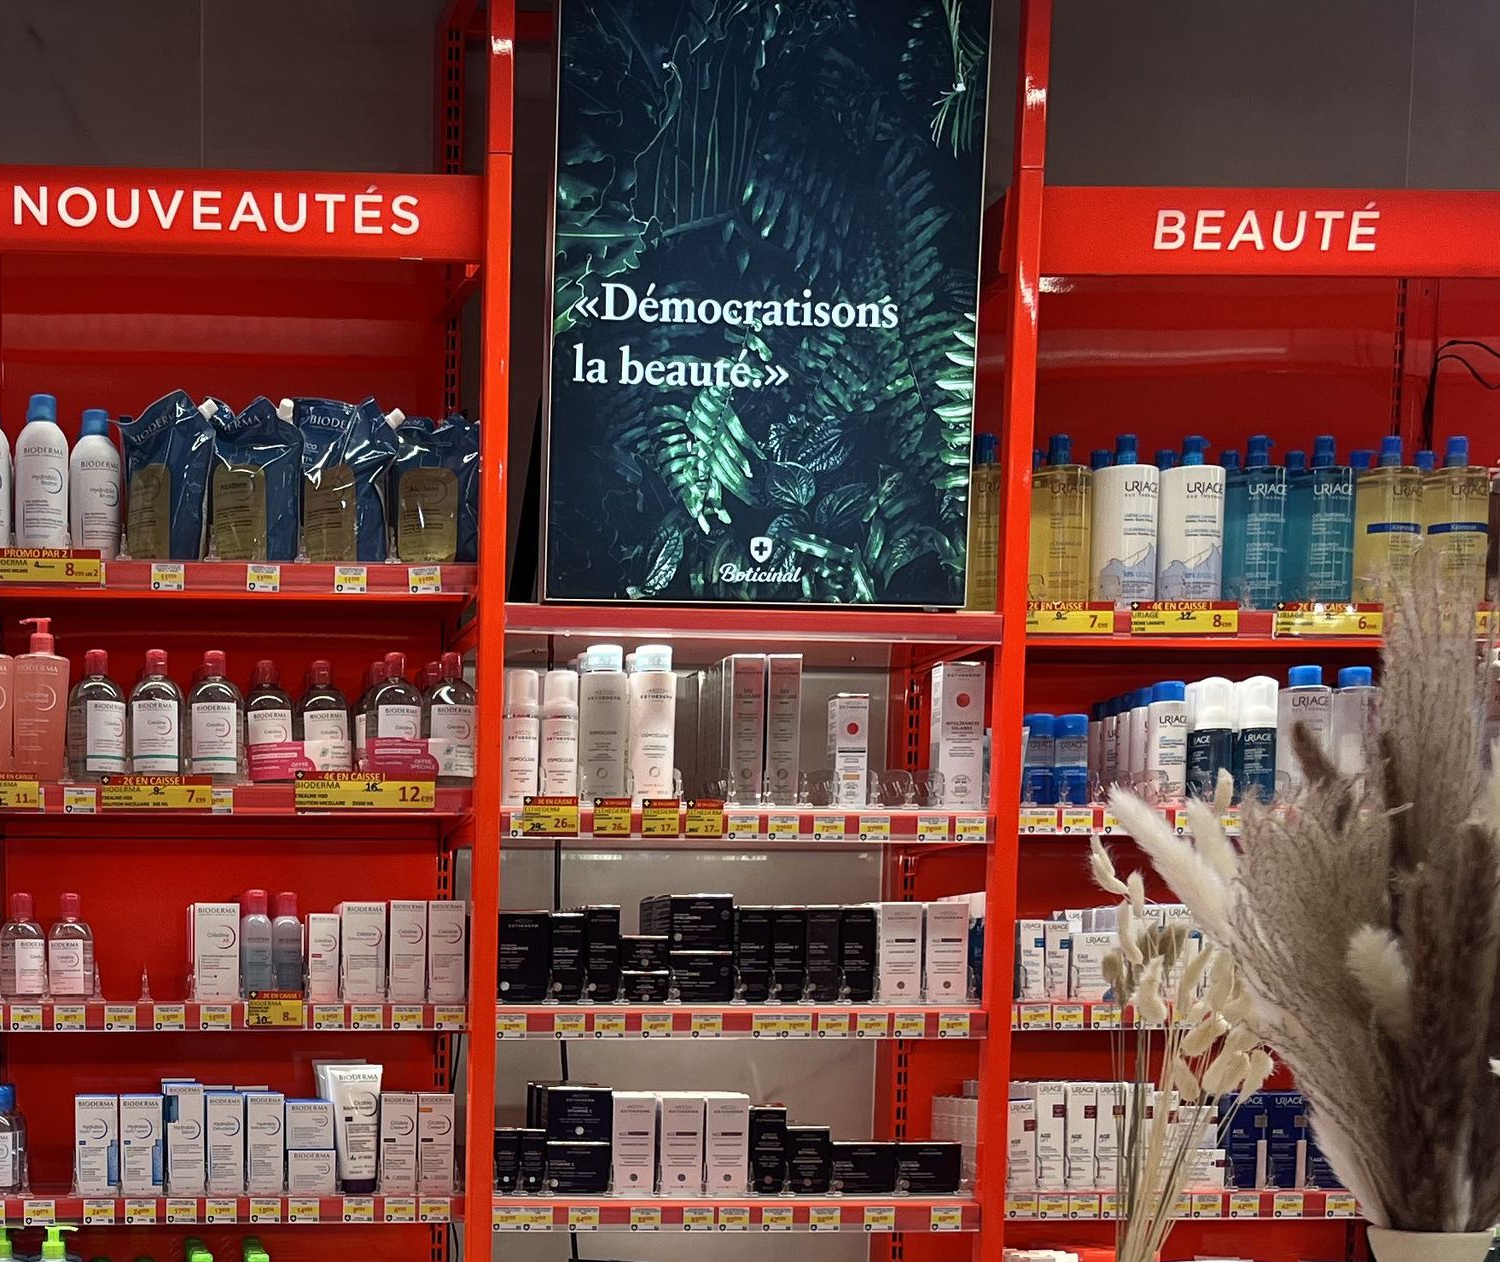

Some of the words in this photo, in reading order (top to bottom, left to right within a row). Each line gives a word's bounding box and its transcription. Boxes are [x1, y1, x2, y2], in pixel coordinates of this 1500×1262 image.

[13, 186, 420, 235] NOUVEAUTÉS
[1153, 203, 1380, 252] BEAUTÉ
[575, 283, 899, 329] «Démocratisons
[573, 344, 608, 384] la
[618, 348, 790, 388] beauté.»
[1314, 483, 1353, 496] URIAGE
[4, 550, 40, 558] PROMO
[42, 550, 60, 558] PAR
[61, 550, 68, 558] 2
[719, 563, 802, 584] Boticinal
[1054, 602, 1084, 611] CAISSE
[1174, 602, 1207, 611] CAISSE
[124, 776, 136, 785] 2€
[139, 777, 152, 785] EN
[154, 777, 181, 785] CAISSE
[324, 773, 336, 782] 4€
[338, 773, 351, 782] EN
[353, 773, 381, 782] CAISSE
[296, 782, 340, 791] BIODERMA
[1086, 935, 1111, 944] URIAGE
